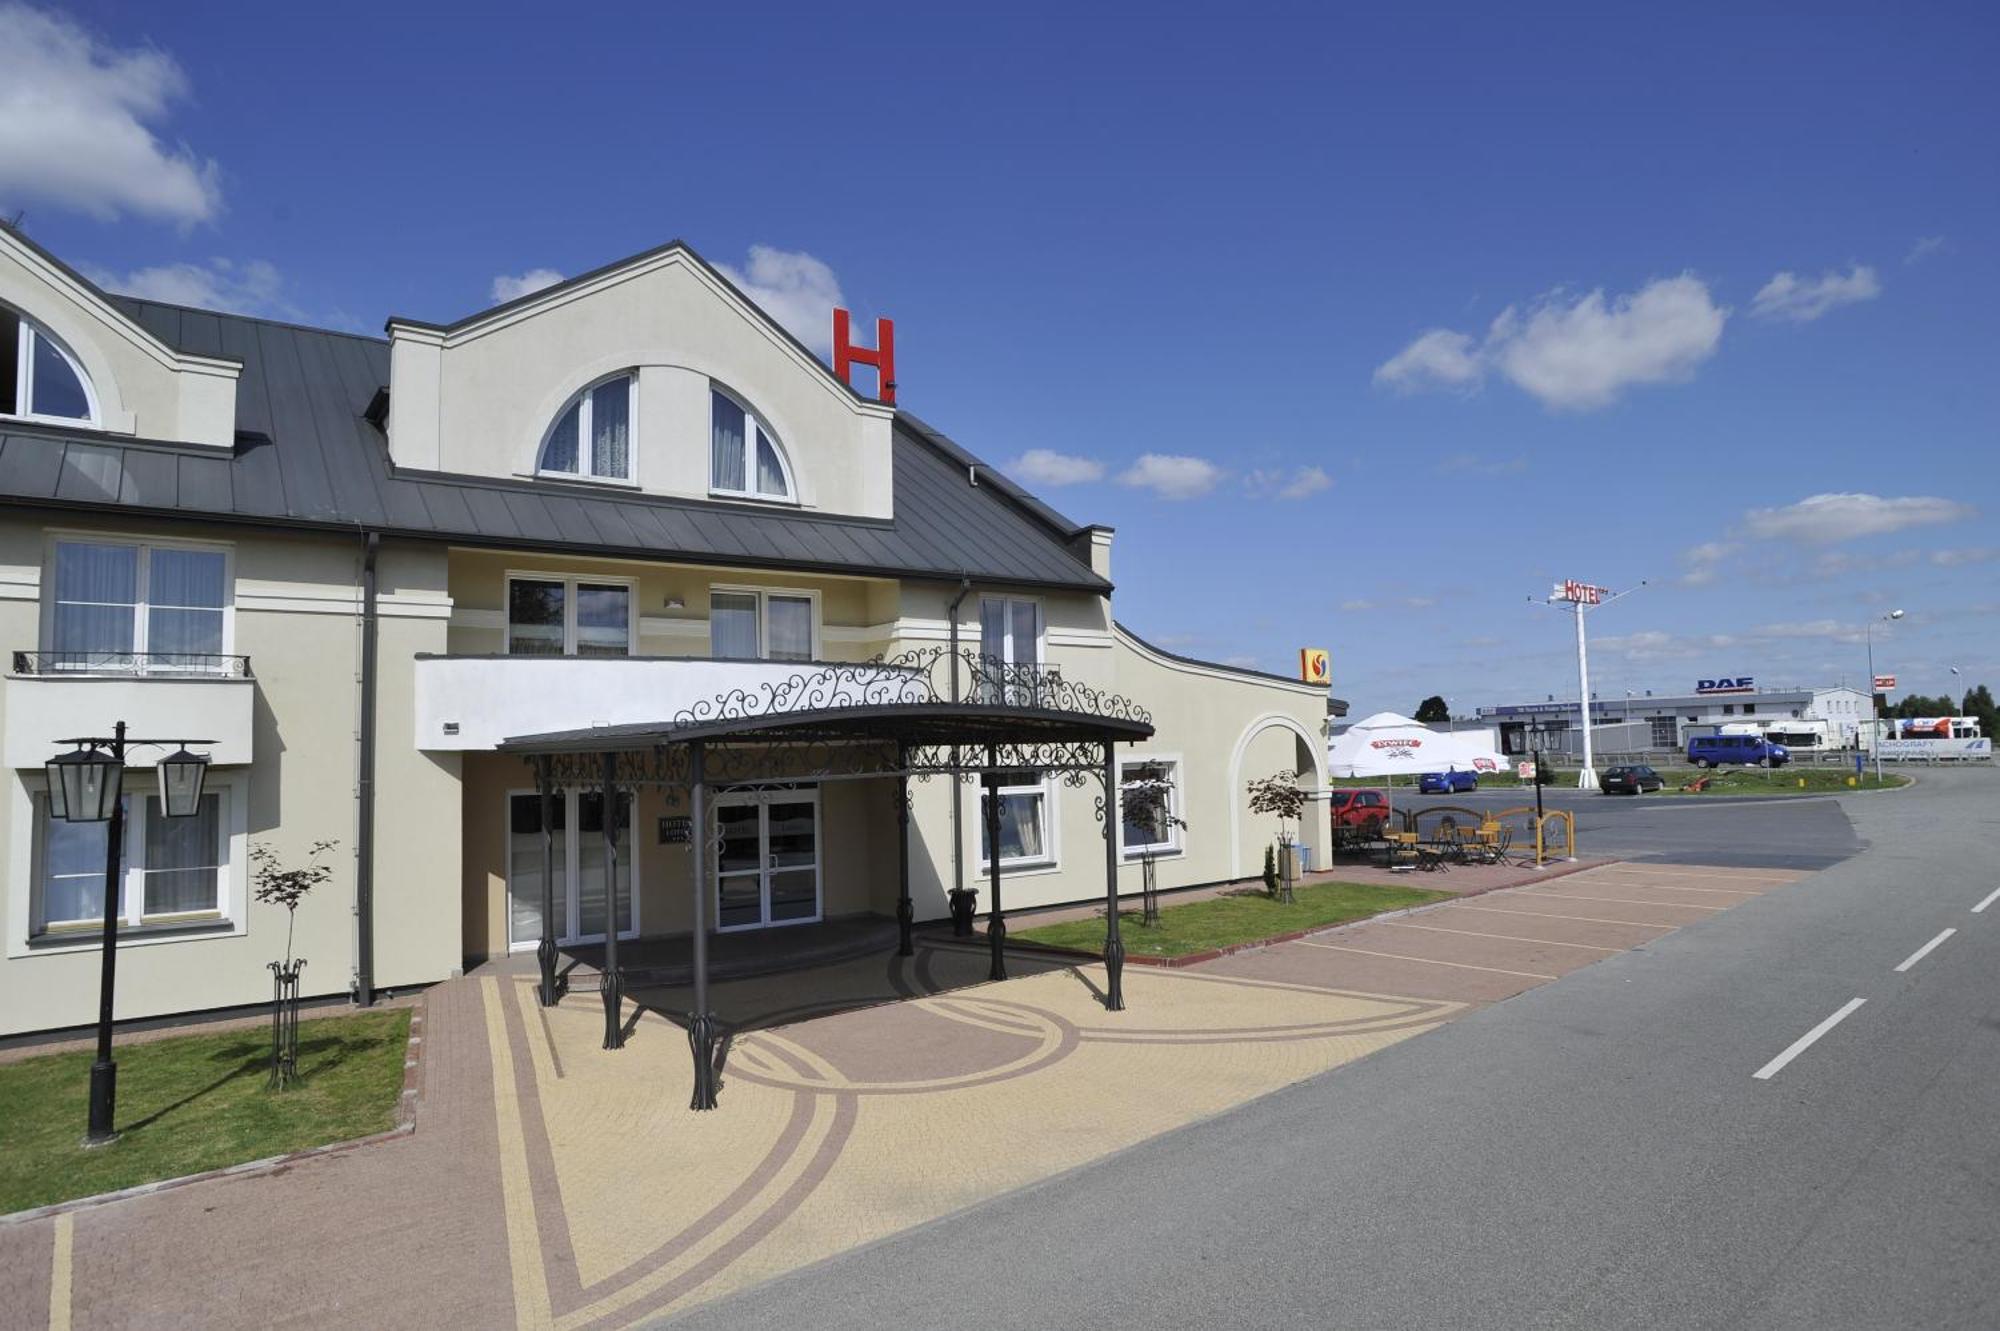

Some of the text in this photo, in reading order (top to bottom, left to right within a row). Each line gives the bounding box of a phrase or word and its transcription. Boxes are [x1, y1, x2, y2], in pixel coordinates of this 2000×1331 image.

[832, 306, 896, 404] H
[1565, 578, 1600, 604] HOTEL
[1697, 677, 1754, 689] DAF
[1875, 740, 1934, 748] ACHOGRAFY
